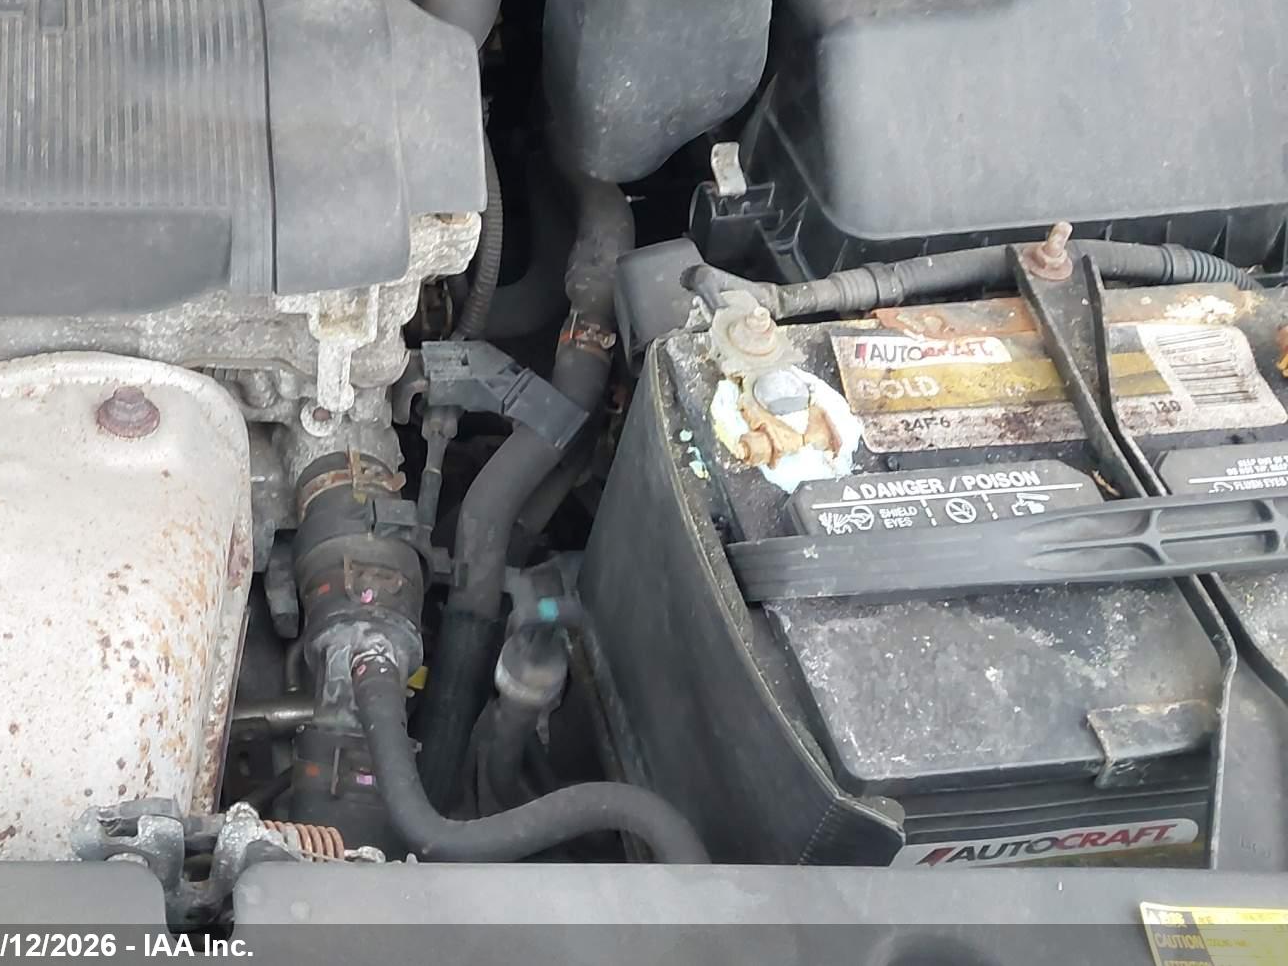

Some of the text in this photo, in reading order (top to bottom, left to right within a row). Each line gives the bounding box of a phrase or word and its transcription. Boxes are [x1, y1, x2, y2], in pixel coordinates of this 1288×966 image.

[859, 375, 941, 400] GOLD
[859, 471, 1041, 500] DANGER / POISON
[879, 506, 918, 518] SHIELD
[884, 516, 914, 529] EYES
[945, 823, 1178, 863] AUTOCRAFT
[1154, 933, 1207, 950] CAUTION
